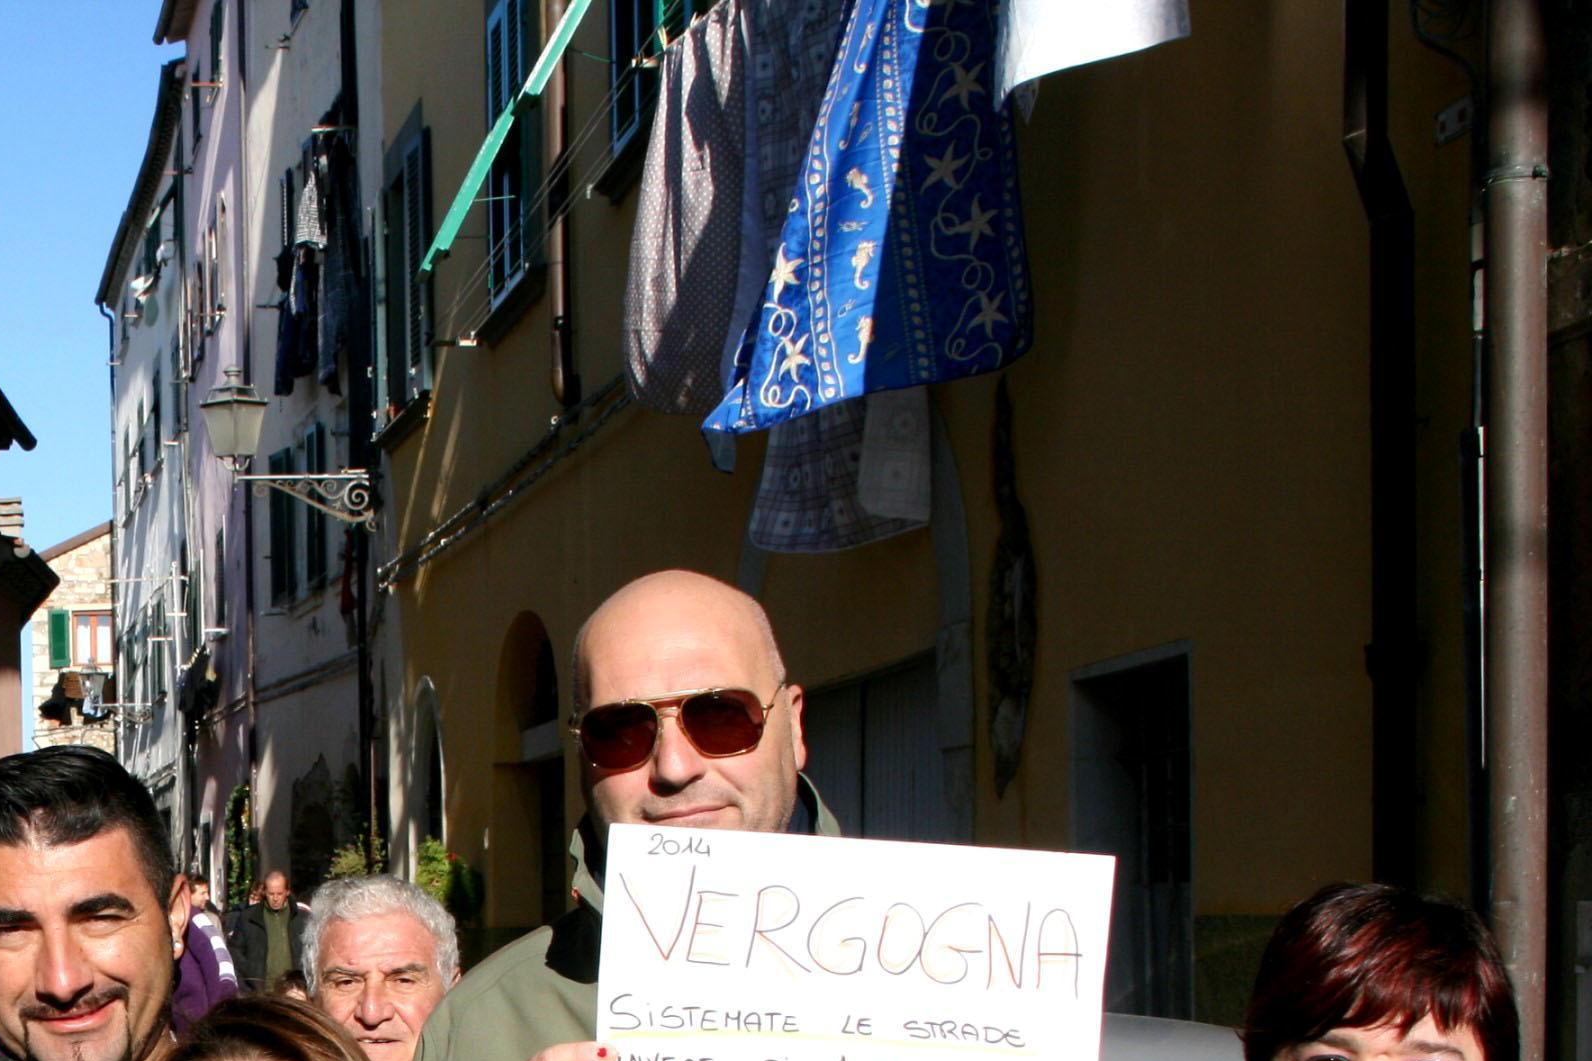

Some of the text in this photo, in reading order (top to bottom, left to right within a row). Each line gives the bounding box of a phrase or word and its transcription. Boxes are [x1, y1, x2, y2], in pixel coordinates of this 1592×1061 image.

[648, 833, 710, 857] 2014
[619, 864, 1083, 1000] VERGOGNA
[841, 1014, 872, 1036] LE
[903, 1020, 1026, 1048] STRADE
